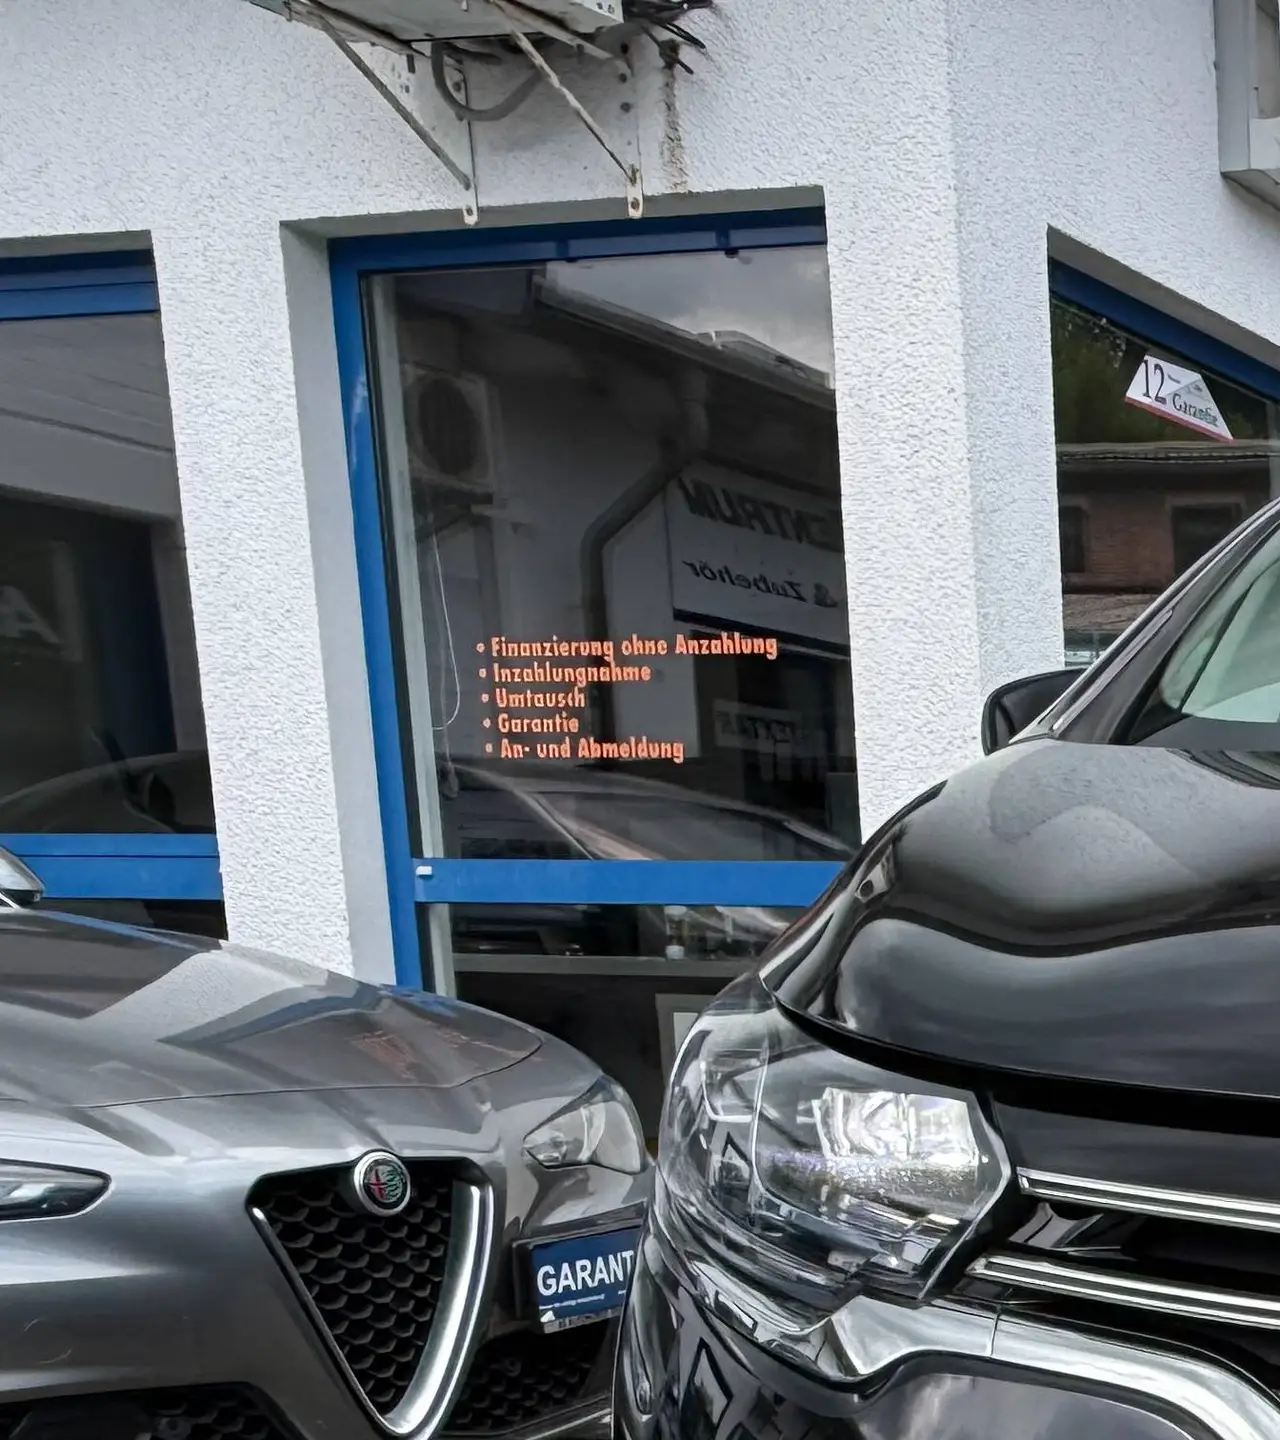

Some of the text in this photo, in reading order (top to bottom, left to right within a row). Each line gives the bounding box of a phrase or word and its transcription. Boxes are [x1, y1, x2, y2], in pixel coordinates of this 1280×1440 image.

[1142, 359, 1167, 405] 12
[491, 632, 778, 661] Finanzierung ohne Anzahlung
[493, 661, 652, 687] Inzahlungnahme
[495, 687, 585, 708] Umtausch
[498, 711, 580, 733] Garantie
[500, 736, 685, 764] An- und Abmeldung
[537, 1250, 635, 1296] GARANT
